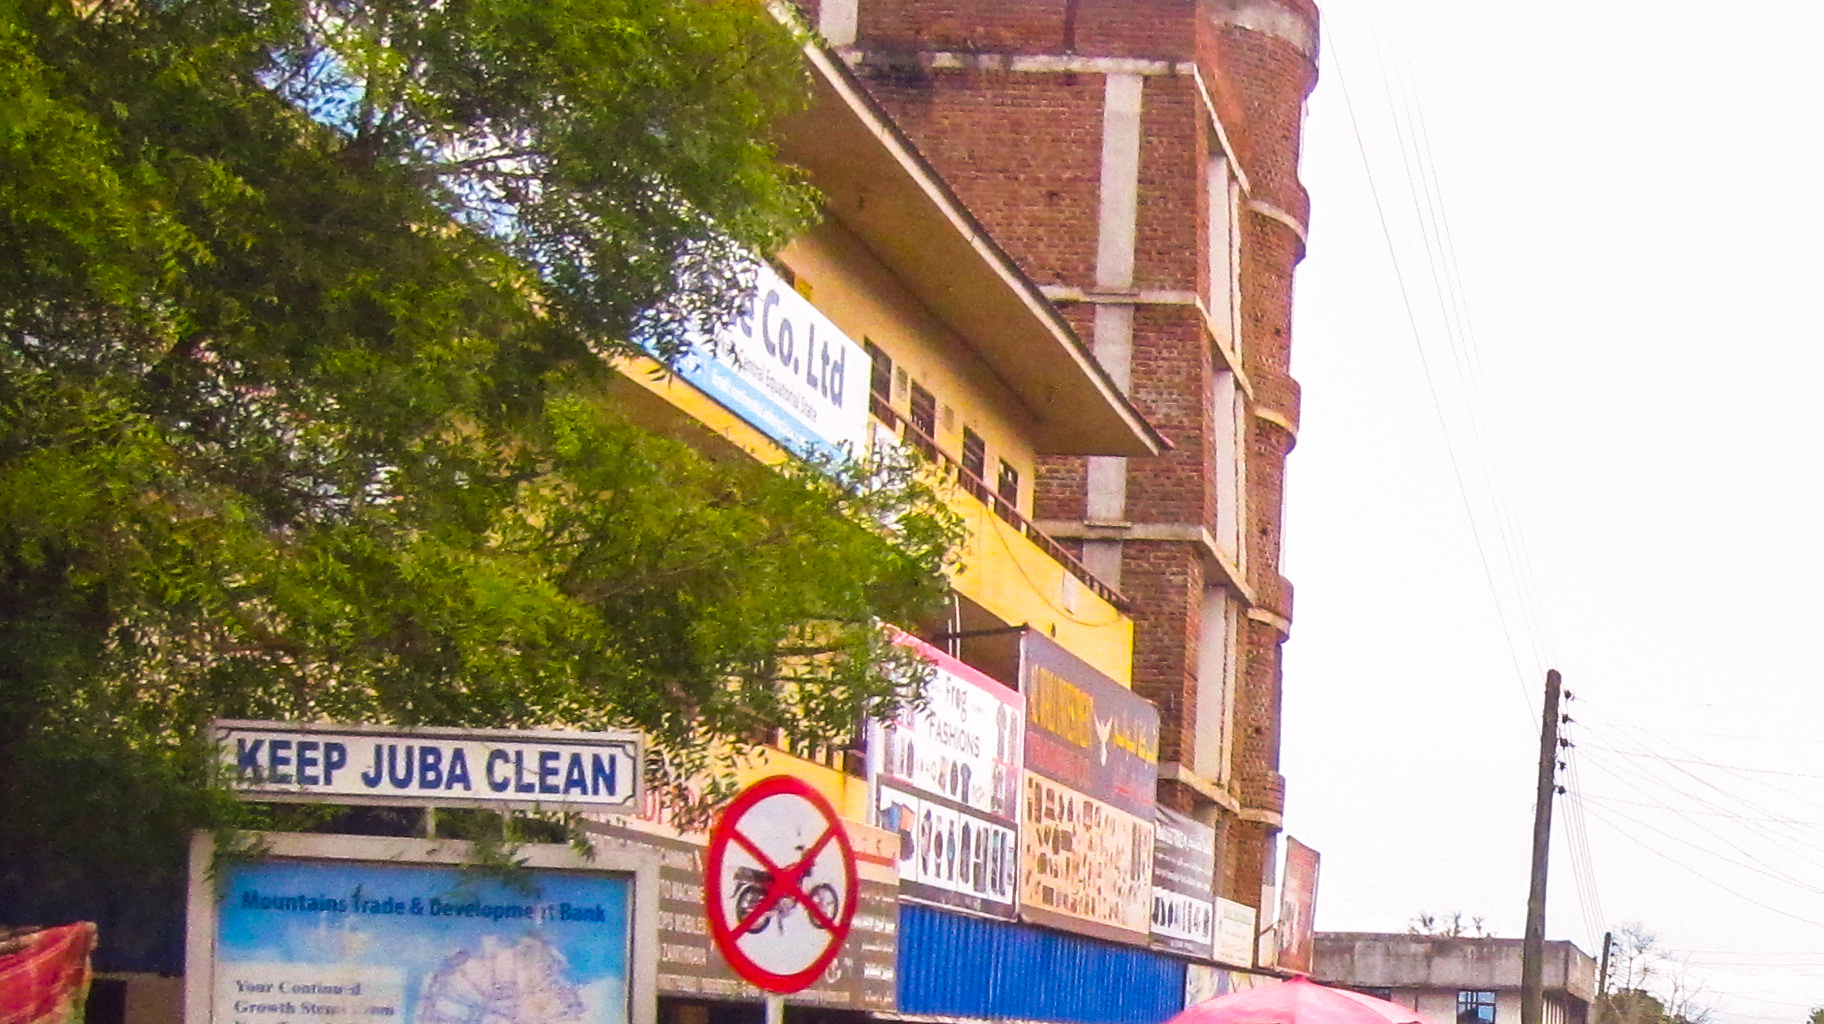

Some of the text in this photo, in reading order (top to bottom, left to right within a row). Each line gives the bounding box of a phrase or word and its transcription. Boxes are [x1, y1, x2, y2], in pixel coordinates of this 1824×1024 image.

[762, 289, 799, 375] Co.
[807, 322, 846, 410] Ltd
[929, 718, 981, 759] FASHIONS
[237, 738, 618, 797] KEEP JUBA CLEAN
[411, 897, 424, 915] &
[560, 902, 605, 922] Bank
[235, 978, 274, 993] Your
[233, 1000, 296, 1014] Growth
